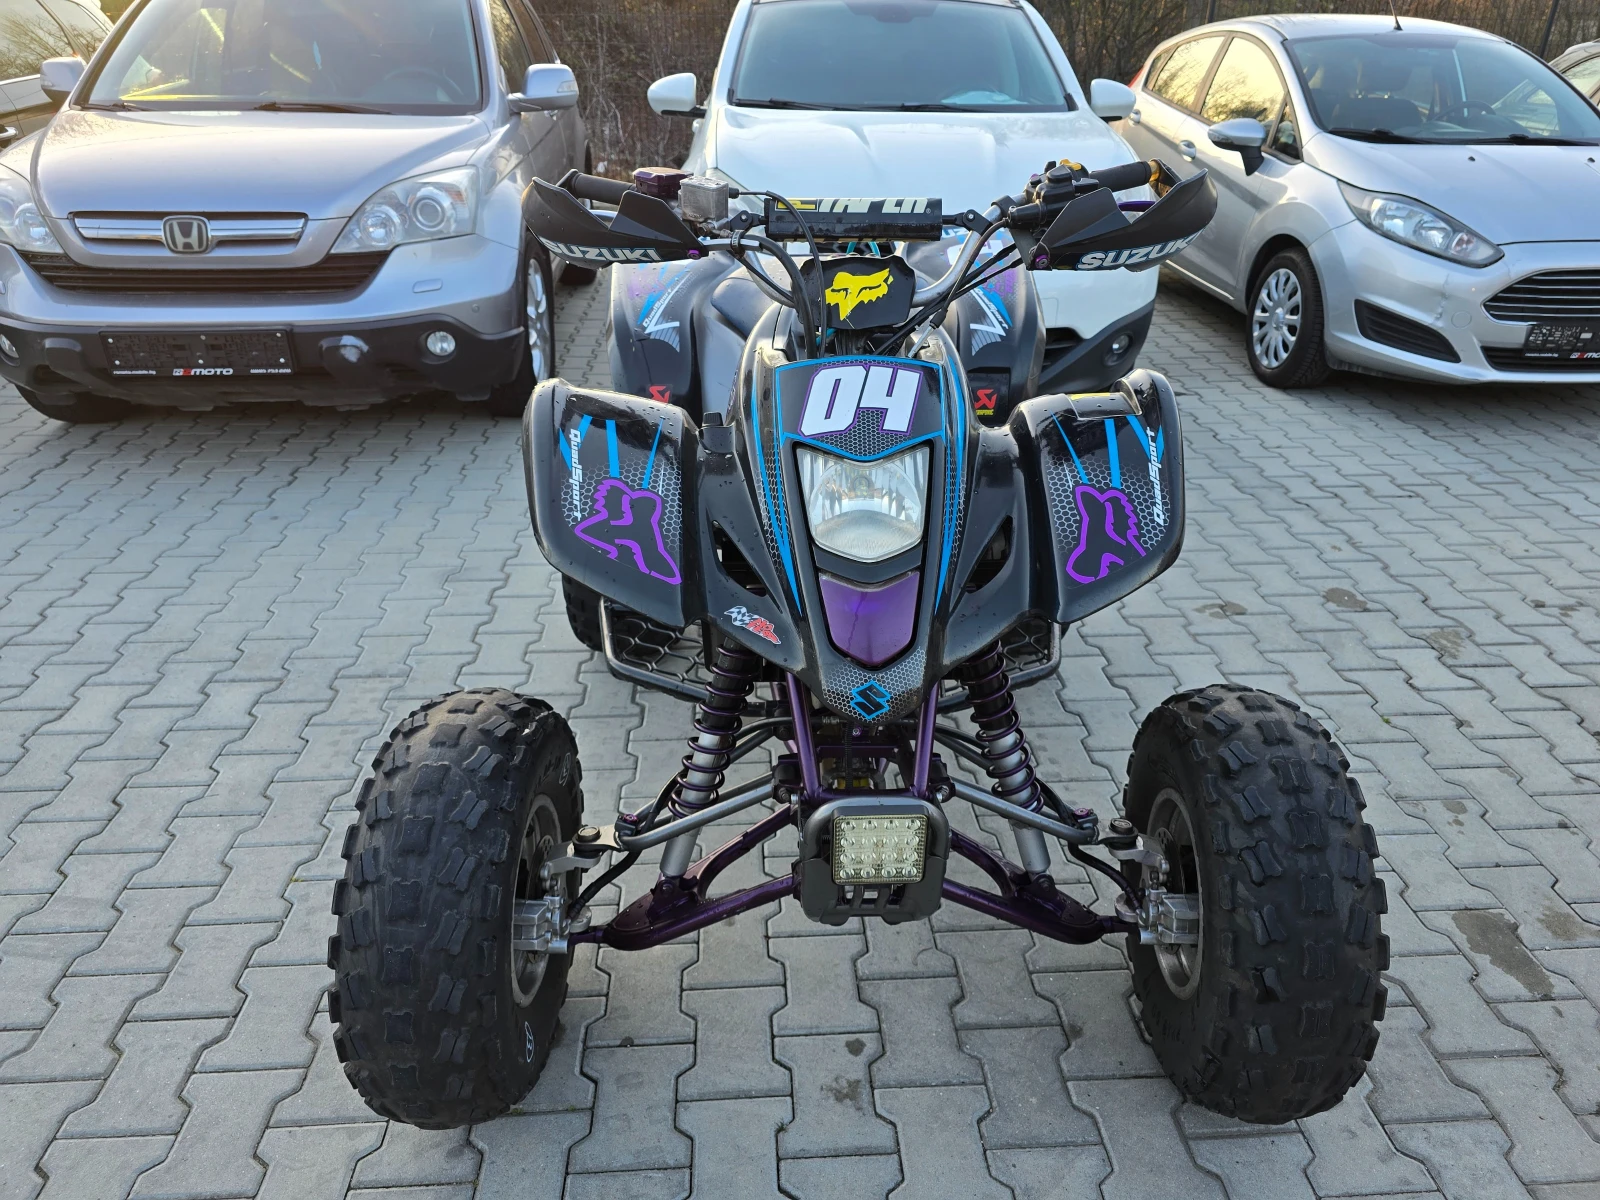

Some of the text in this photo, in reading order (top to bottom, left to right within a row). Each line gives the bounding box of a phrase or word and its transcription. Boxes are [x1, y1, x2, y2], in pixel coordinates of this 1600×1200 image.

[538, 236, 662, 261] SUZUKI
[798, 364, 924, 439] 04
[568, 428, 583, 522] QuadSport
[1146, 426, 1165, 527] QuadSport
